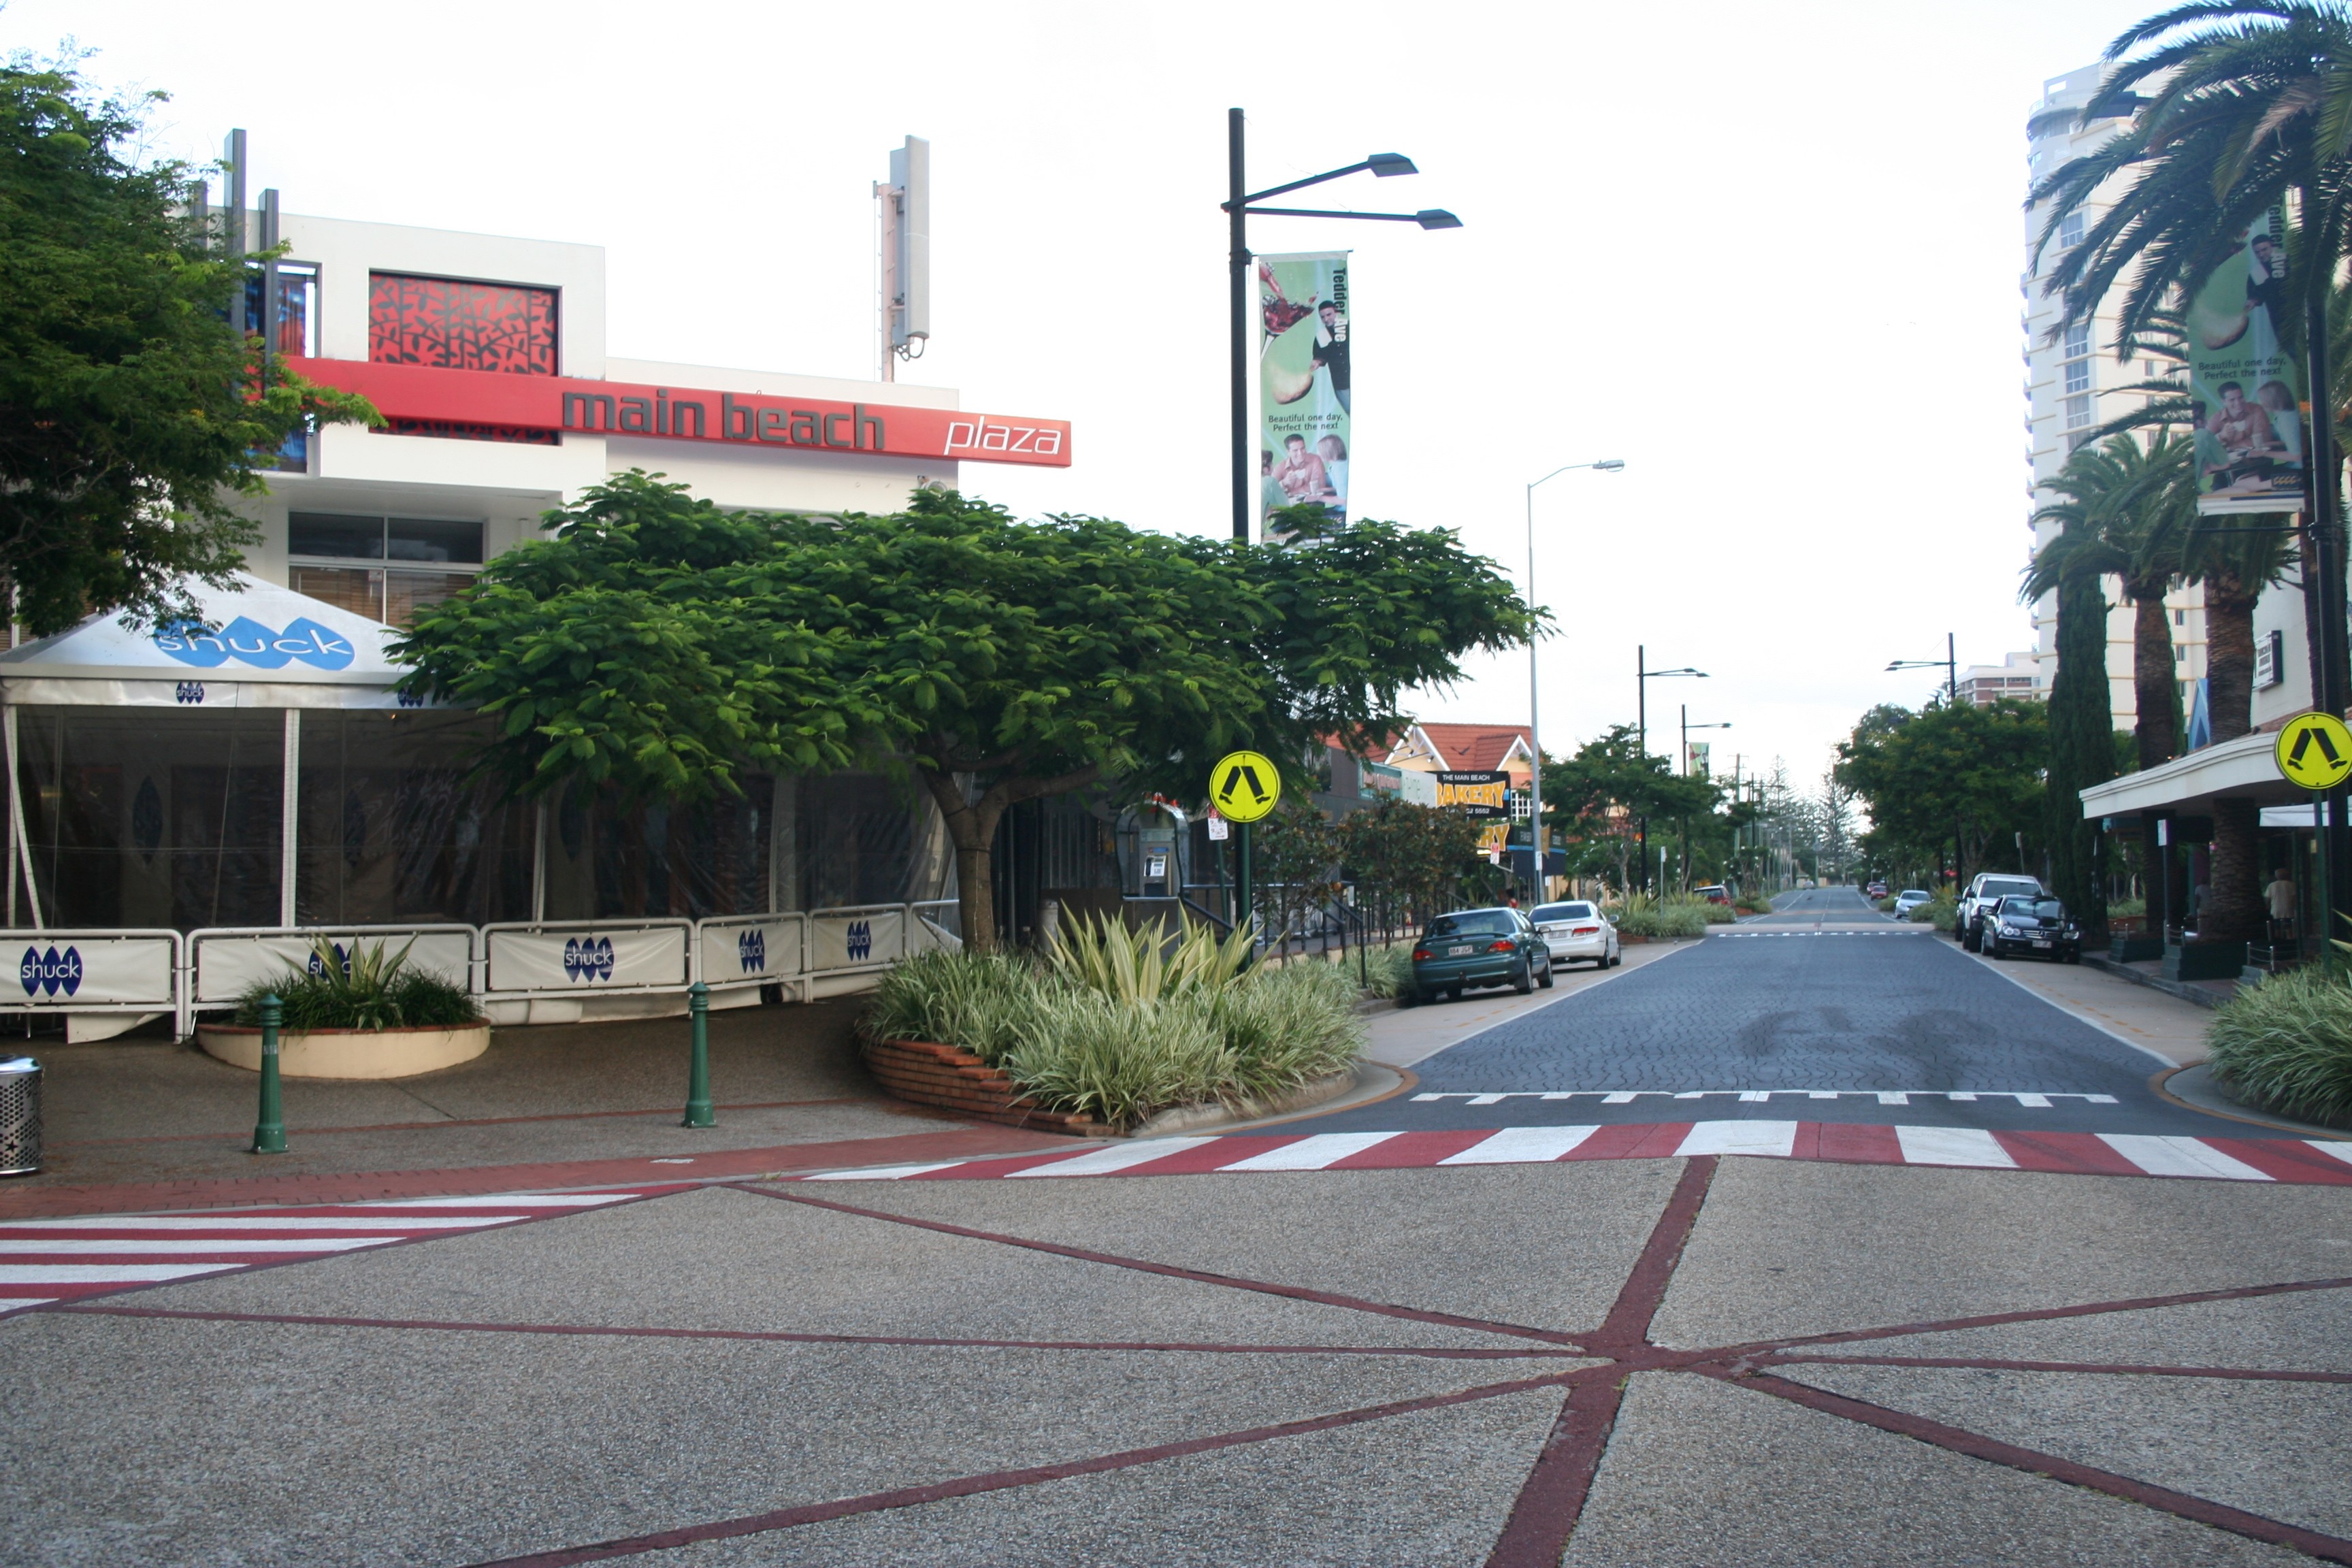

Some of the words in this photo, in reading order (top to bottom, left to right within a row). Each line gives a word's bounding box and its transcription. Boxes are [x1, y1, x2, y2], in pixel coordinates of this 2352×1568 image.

[2271, 252, 2287, 278] Ave
[1333, 267, 1347, 315] Tedder
[1334, 316, 1348, 342] Ave
[2198, 359, 2240, 370] Beautiful
[2244, 359, 2262, 367] one
[2204, 370, 2237, 380] Perfect
[2241, 369, 2256, 377] the
[2261, 368, 2281, 376] next
[562, 388, 706, 439] main
[721, 393, 885, 450] beach
[943, 414, 1063, 456] plaza
[1269, 413, 1305, 423] Beautiful
[1273, 423, 1301, 431] Perfect
[158, 625, 353, 654] shuck
[177, 686, 203, 698] shuck
[1436, 781, 1506, 808] BAKERY
[740, 937, 764, 958] shuck
[848, 928, 870, 947] shuck
[565, 945, 612, 966] shuck
[22, 956, 80, 978] shuck
